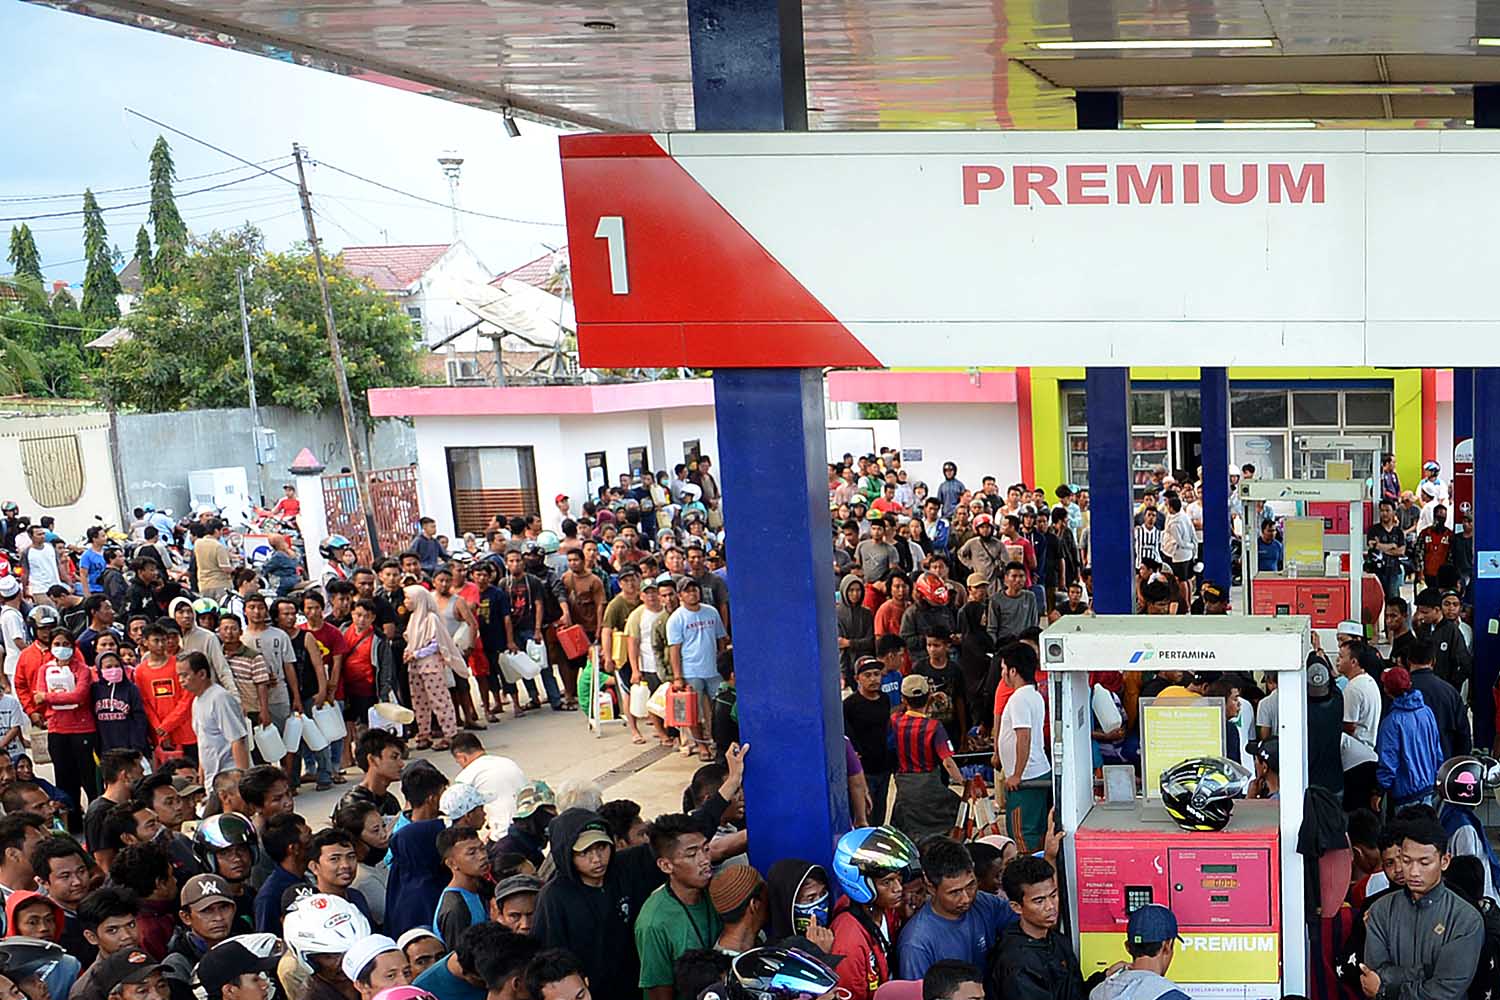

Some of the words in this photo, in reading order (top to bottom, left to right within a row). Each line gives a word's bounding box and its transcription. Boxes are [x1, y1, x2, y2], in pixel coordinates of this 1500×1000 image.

[962, 164, 1325, 206] PREMIUM
[593, 216, 631, 295] 1
[1158, 650, 1216, 660] PERTAMINA
[1180, 936, 1275, 952] PREMIUM
